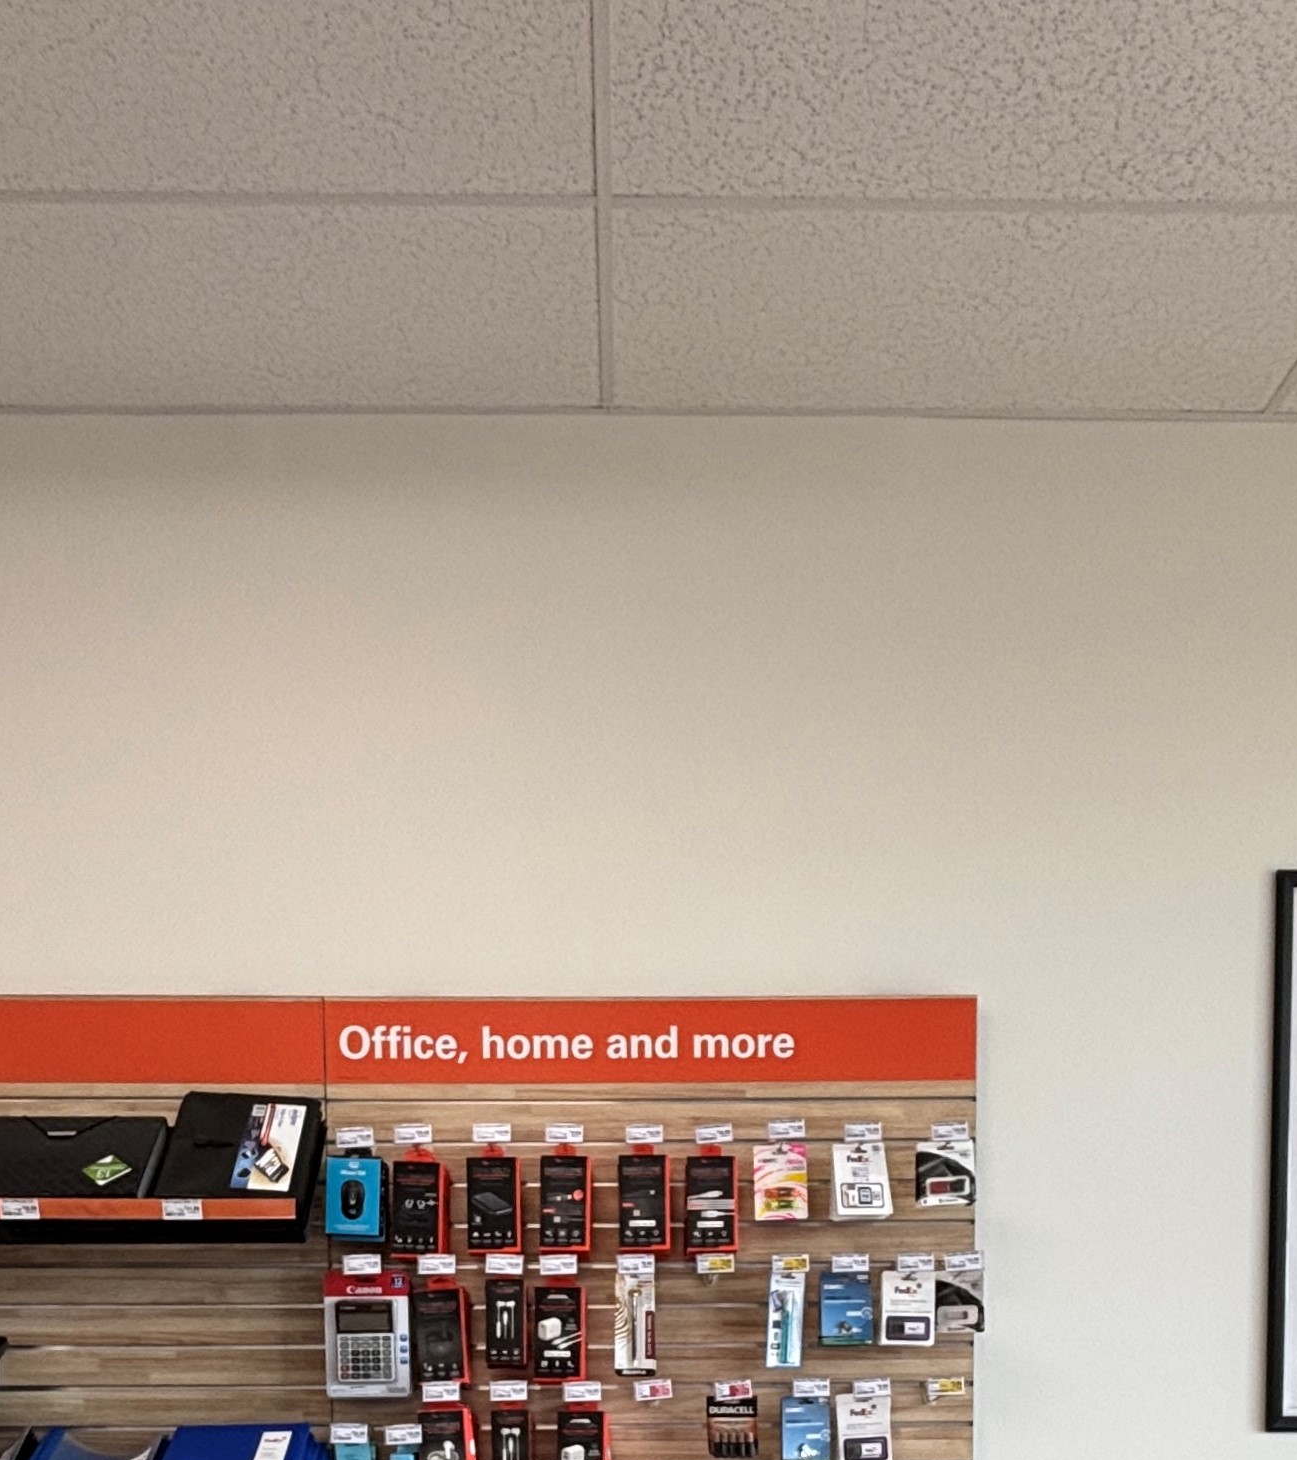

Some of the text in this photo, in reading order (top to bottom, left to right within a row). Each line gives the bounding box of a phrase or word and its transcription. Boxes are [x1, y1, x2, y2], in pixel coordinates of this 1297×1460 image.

[338, 1024, 795, 1064] Office, home and more
[345, 1285, 383, 1295] Canon
[708, 1405, 755, 1416] DURACELL
